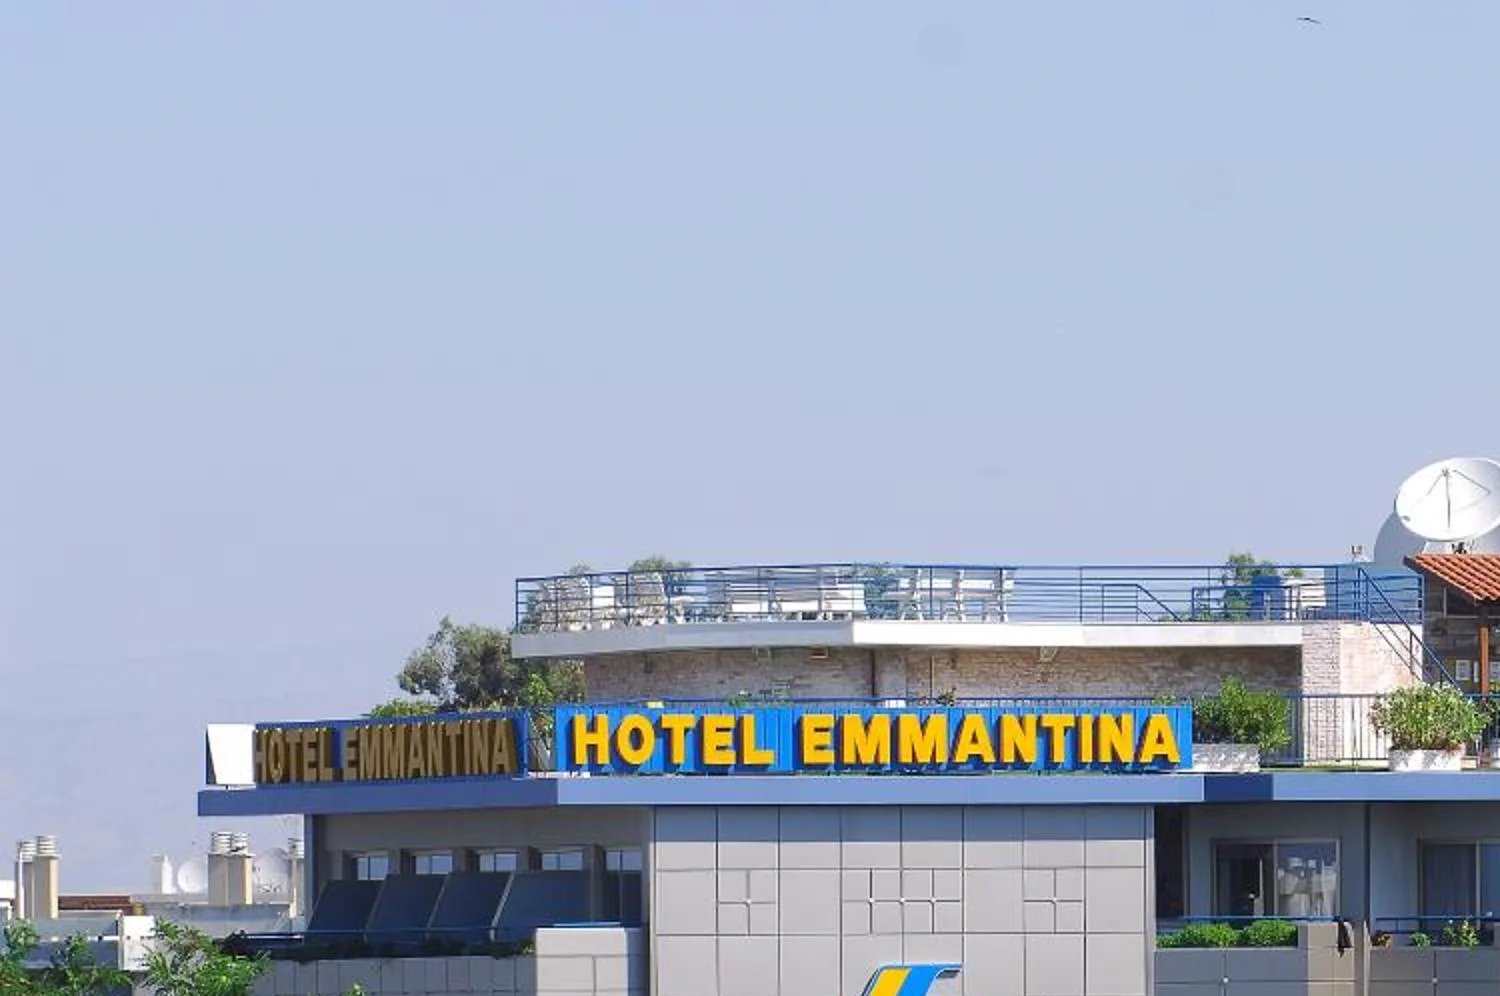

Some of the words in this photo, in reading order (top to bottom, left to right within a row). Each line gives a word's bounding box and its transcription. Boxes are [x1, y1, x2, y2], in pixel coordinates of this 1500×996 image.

[252, 728, 332, 783] HOTEL
[343, 718, 513, 780] EMMANTINA
[574, 714, 776, 764] HOTEL
[803, 714, 1181, 764] EMMANTINA
